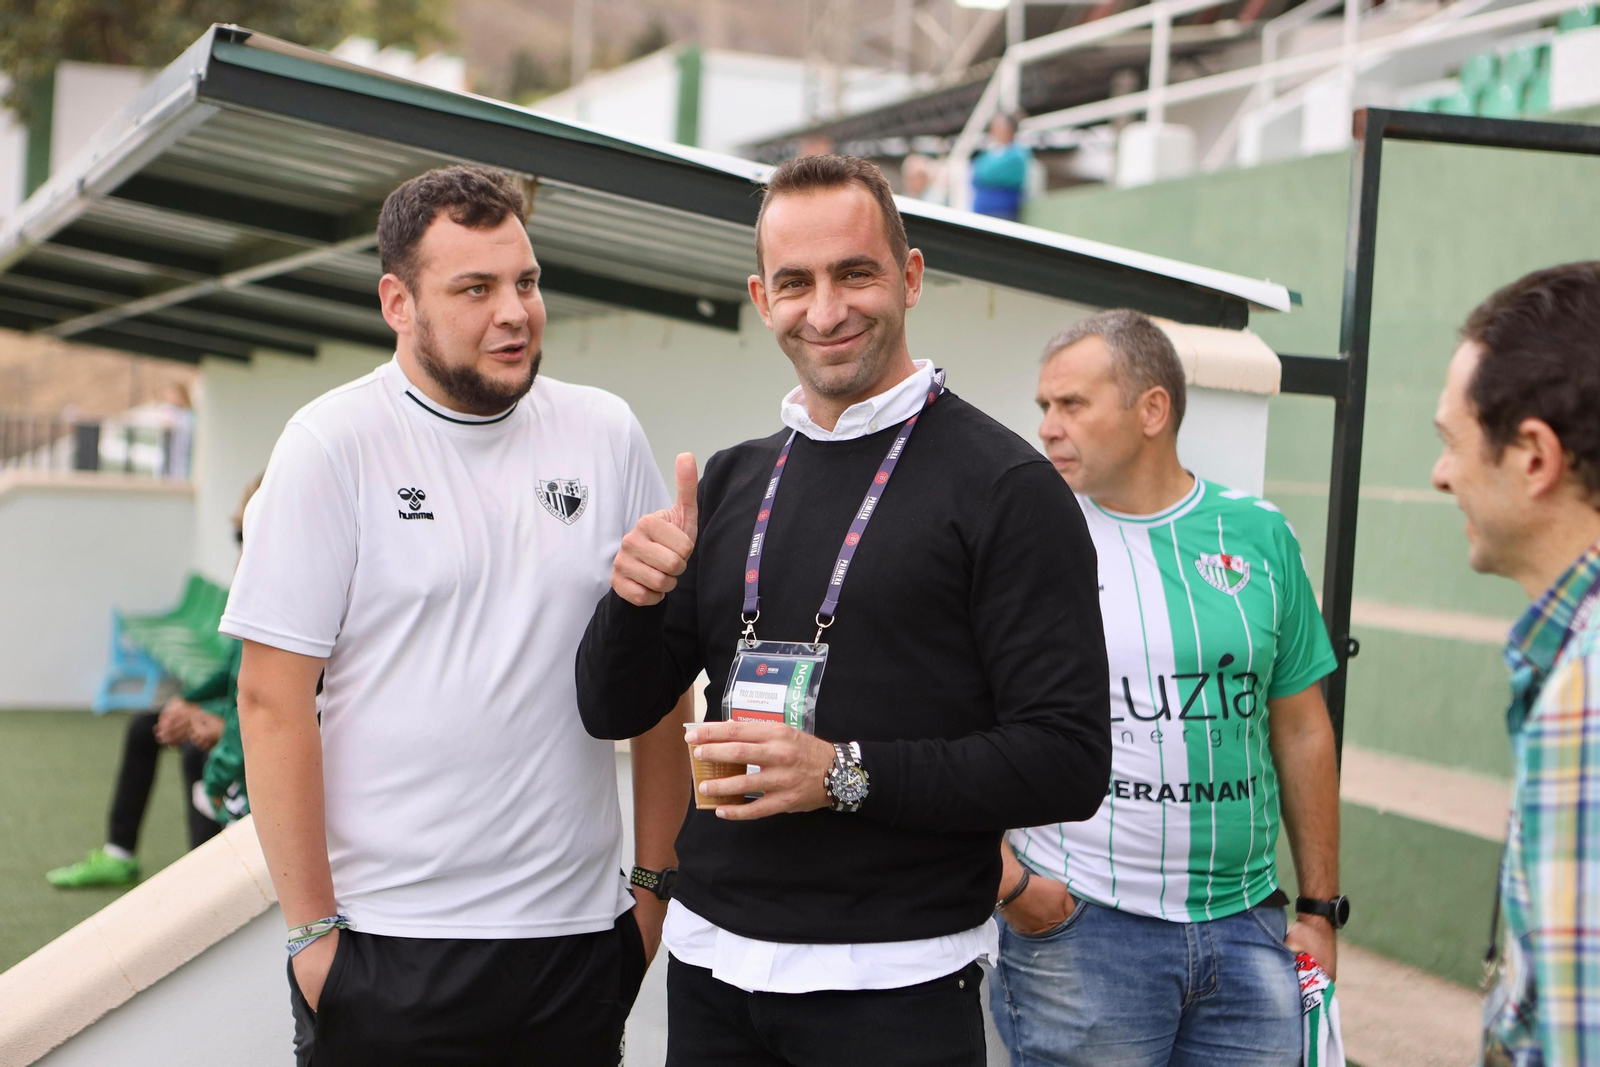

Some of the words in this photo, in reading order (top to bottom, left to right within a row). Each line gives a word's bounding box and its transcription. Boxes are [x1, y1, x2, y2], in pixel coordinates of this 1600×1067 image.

[398, 509, 434, 521] hummel
[860, 496, 878, 520] PRIMERA
[833, 559, 849, 586] PRIMERA
[1111, 654, 1259, 723] uzía
[1120, 723, 1254, 748] nergía
